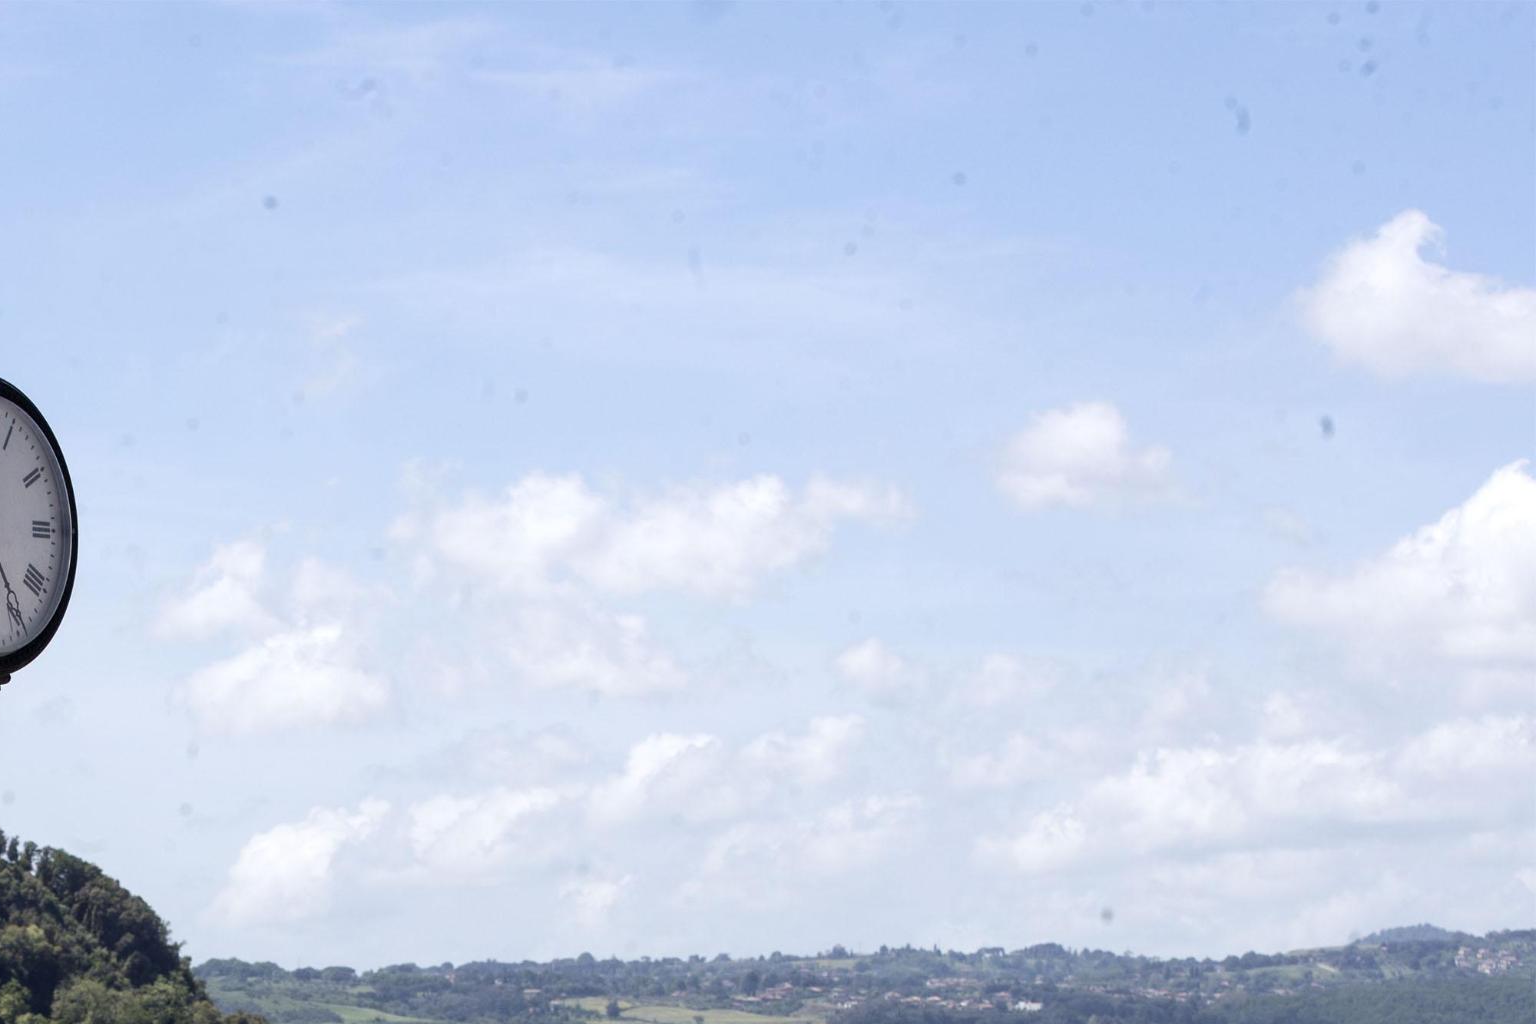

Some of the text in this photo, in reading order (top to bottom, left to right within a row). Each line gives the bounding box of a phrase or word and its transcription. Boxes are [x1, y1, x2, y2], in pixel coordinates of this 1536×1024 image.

[3, 425, 13, 450] I
[23, 467, 41, 488] II
[32, 520, 51, 539] III
[23, 563, 45, 597] IIII
